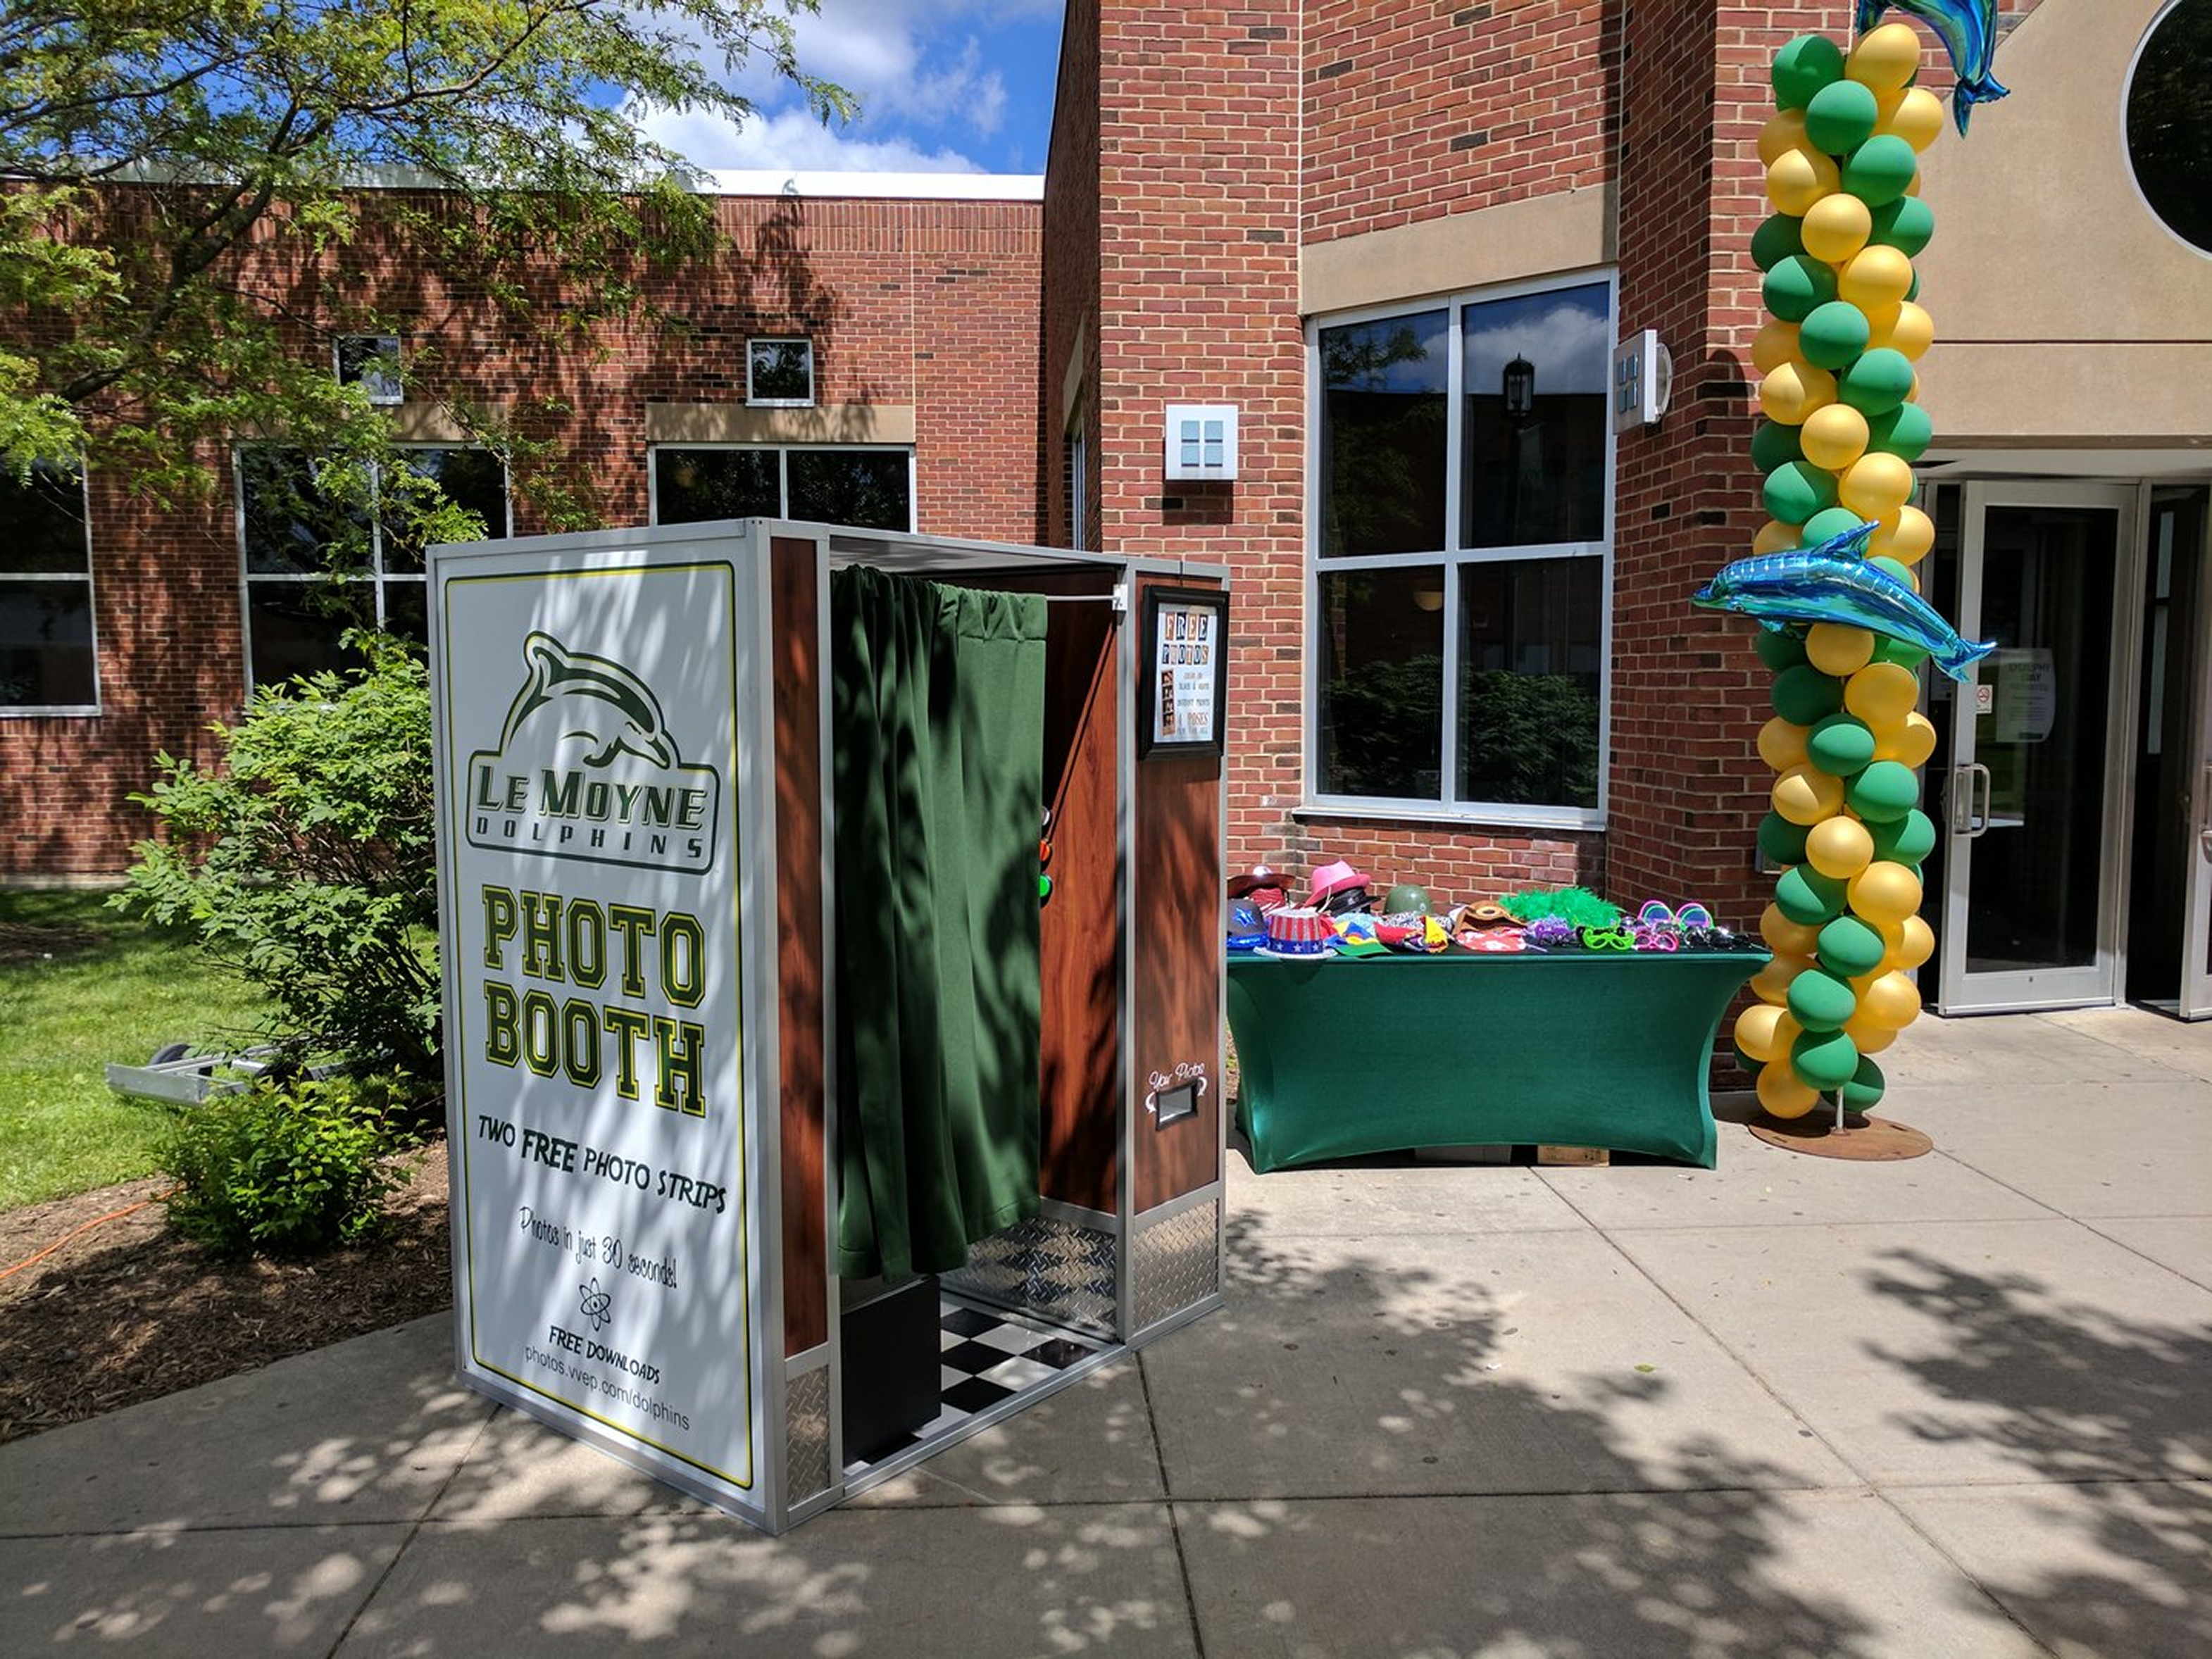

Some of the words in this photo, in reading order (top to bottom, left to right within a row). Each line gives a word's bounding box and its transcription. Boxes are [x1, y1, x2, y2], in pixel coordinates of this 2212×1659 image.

[1163, 644, 1209, 665] PHOTOS
[1166, 612, 1208, 641] FREE
[477, 765, 530, 814] LE
[538, 768, 708, 831] MOYNE
[476, 816, 703, 858] DOLPHINS
[482, 884, 706, 1010] PHOTO
[484, 979, 706, 1118] BOOTH
[479, 1115, 516, 1148] TWO
[521, 1128, 578, 1173] FREE
[583, 1147, 651, 1191] PHOTO
[657, 1170, 727, 1215] STRIPS
[519, 1206, 560, 1246] Photos
[563, 1227, 573, 1251] in
[575, 1230, 597, 1265] just
[602, 1236, 623, 1270] 30
[628, 1253, 677, 1289] seconds!
[549, 1325, 584, 1356] FREE
[586, 1340, 661, 1385] DOWNLOADS
